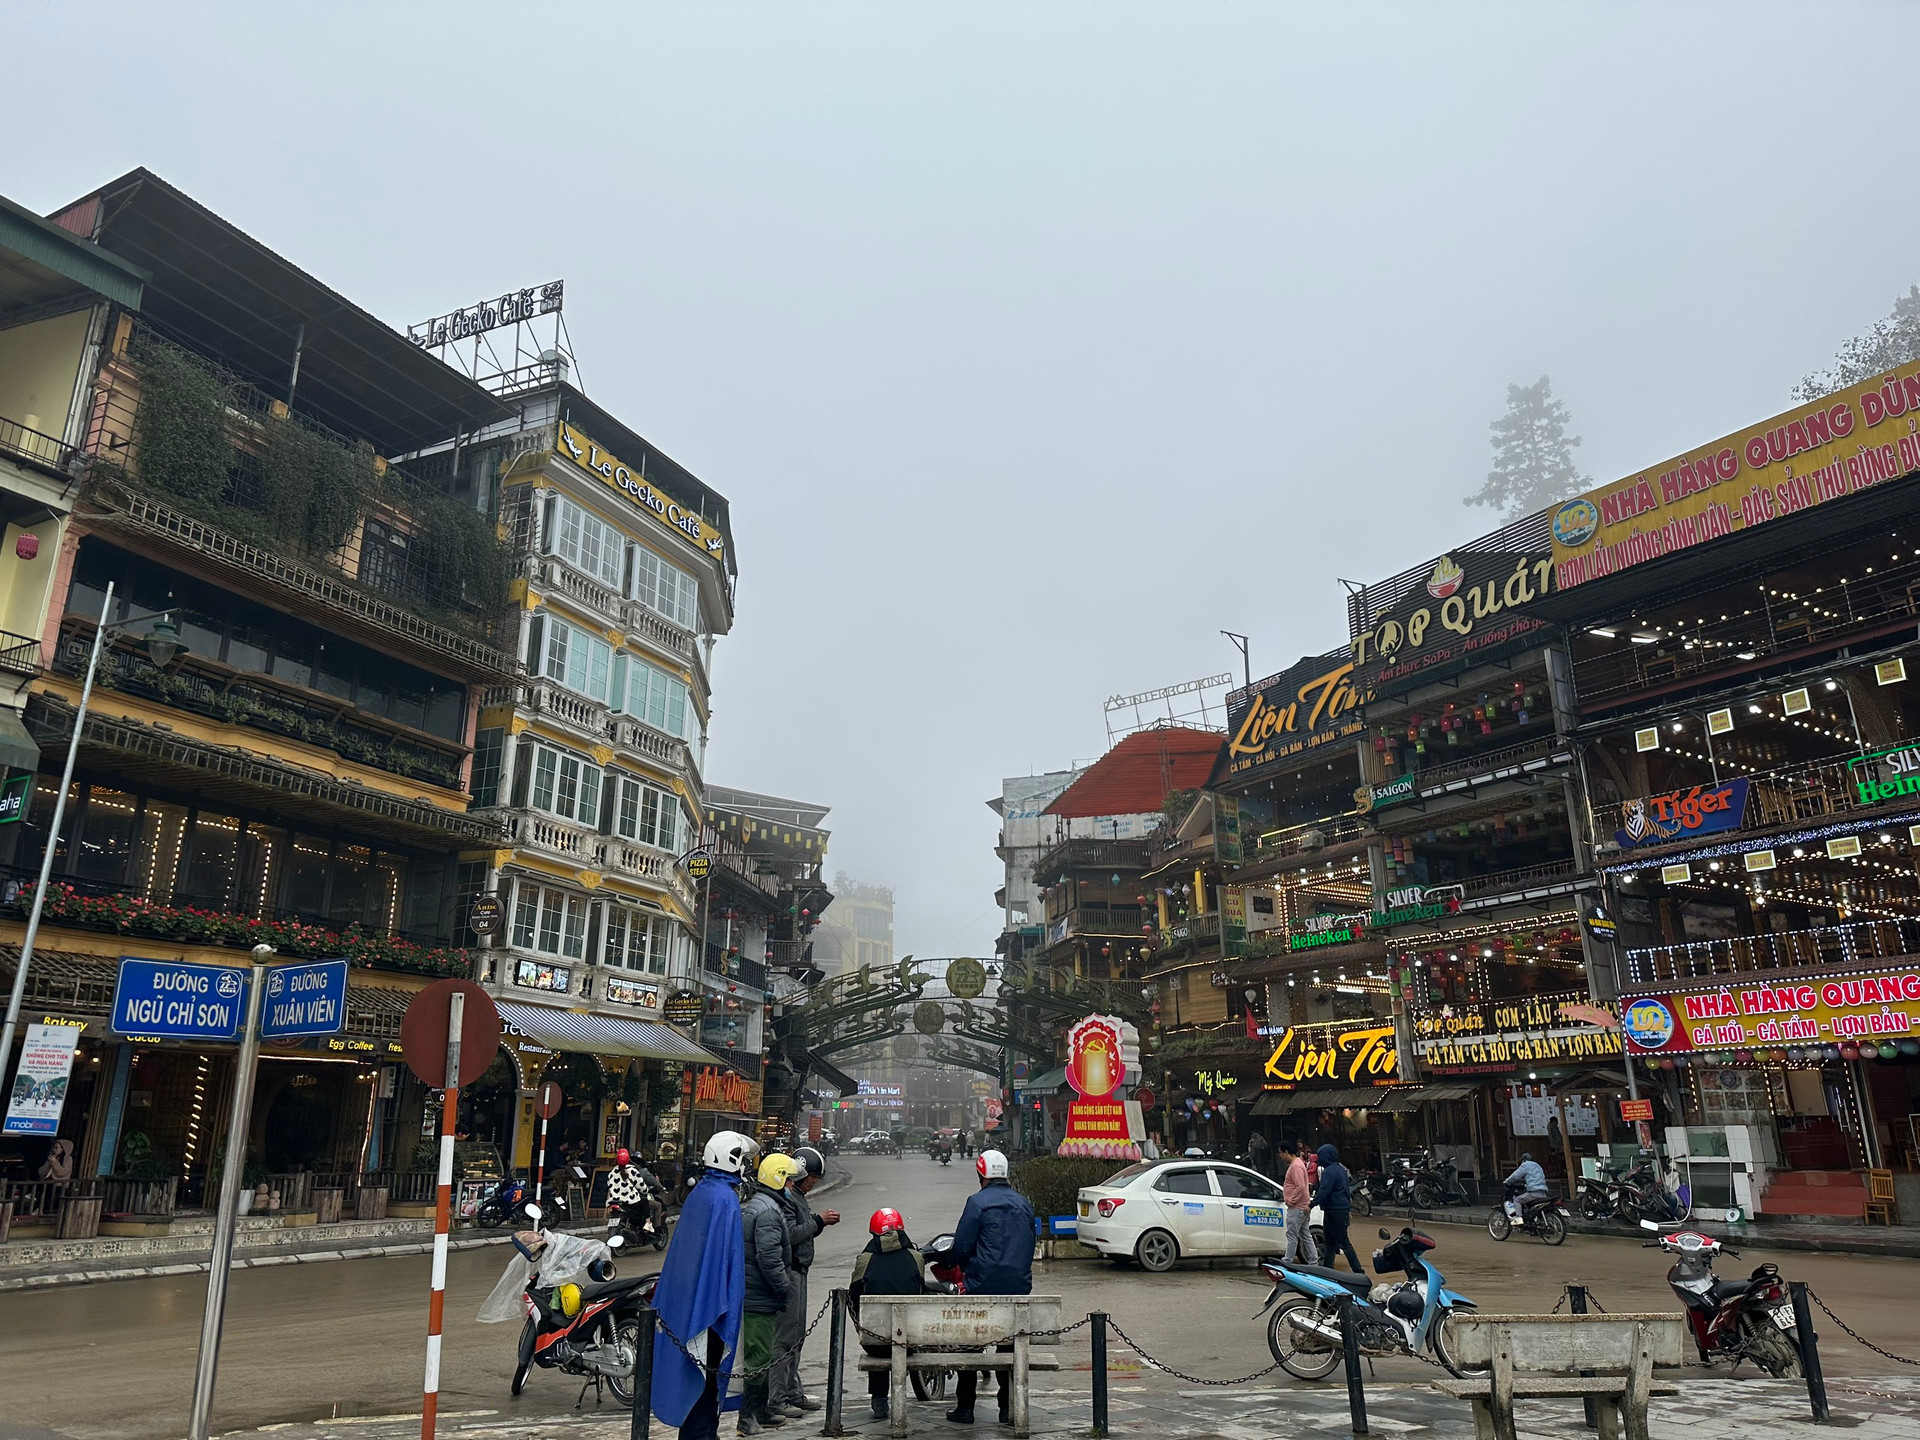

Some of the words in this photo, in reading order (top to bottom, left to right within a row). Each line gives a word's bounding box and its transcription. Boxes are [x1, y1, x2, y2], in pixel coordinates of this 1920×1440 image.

[425, 317, 447, 349] Le
[450, 300, 496, 340] Gecko
[497, 288, 535, 326] Café
[1600, 475, 1658, 527] NHÀ
[1659, 448, 1738, 503] HÀNG
[1745, 402, 1854, 469] QUANG
[588, 445, 612, 478] Le
[615, 467, 665, 514] Gecko
[667, 504, 701, 539] Café
[1558, 553, 1586, 591] CƠM
[1588, 537, 1613, 580] LẨU
[1614, 527, 1662, 571] NƯỚNG
[1662, 516, 1698, 552] BÌNH
[1699, 502, 1732, 543] DÂN
[1741, 487, 1774, 528] ĐẶC
[1776, 465, 1813, 517] SẢN
[1812, 456, 1847, 502] THÚ
[1847, 443, 1897, 490] RỪNG
[1423, 649, 1452, 667] SaPa
[1129, 673, 1232, 705] INTERBOOKING
[1228, 694, 1298, 759] Liên
[1376, 780, 1412, 799] SAIGON
[1650, 785, 1733, 829] Tiger
[689, 868, 708, 876] STEAK
[690, 859, 708, 867] PIZZA
[1386, 887, 1423, 908] SILVER
[479, 920, 489, 928] 04
[1304, 916, 1335, 933] SILVER
[1371, 902, 1445, 927] Heineken
[1291, 928, 1351, 950] Heineken
[153, 970, 209, 993] ĐƯỜNG
[290, 969, 328, 992] ĐƯỜNG
[1684, 987, 1740, 1020] NHÀ
[1741, 983, 1817, 1015] HÀNG
[1821, 973, 1920, 1008] QUANG
[126, 995, 163, 1024] NGŨ
[166, 995, 196, 1026] CHỈ
[196, 1003, 230, 1028] SƠN
[271, 996, 303, 1027] XUÂN
[1495, 1005, 1520, 1028] CƠM
[1525, 995, 1552, 1025] LẨU
[43, 1016, 89, 1033] Bakery
[1692, 1022, 1715, 1046] CÁ
[1717, 1015, 1745, 1044] HỒI
[1757, 1017, 1780, 1042] CÁ
[1781, 1014, 1818, 1040] TẦM
[1831, 1013, 1867, 1040] LỢN
[1868, 1005, 1910, 1034] BẢN
[329, 1039, 345, 1050] Egg
[347, 1040, 374, 1051] Coffee
[388, 1042, 403, 1053] Fres
[1264, 1027, 1339, 1081] Liên
[1426, 1041, 1442, 1066] CÁ
[1471, 1037, 1488, 1063] CÁ
[1489, 1032, 1511, 1062] HỒI
[1567, 1032, 1597, 1061] LỢN
[887, 1087, 900, 1095] Mart
[10, 1120, 51, 1130] mobifone
[941, 1309, 962, 1320] TAXI
